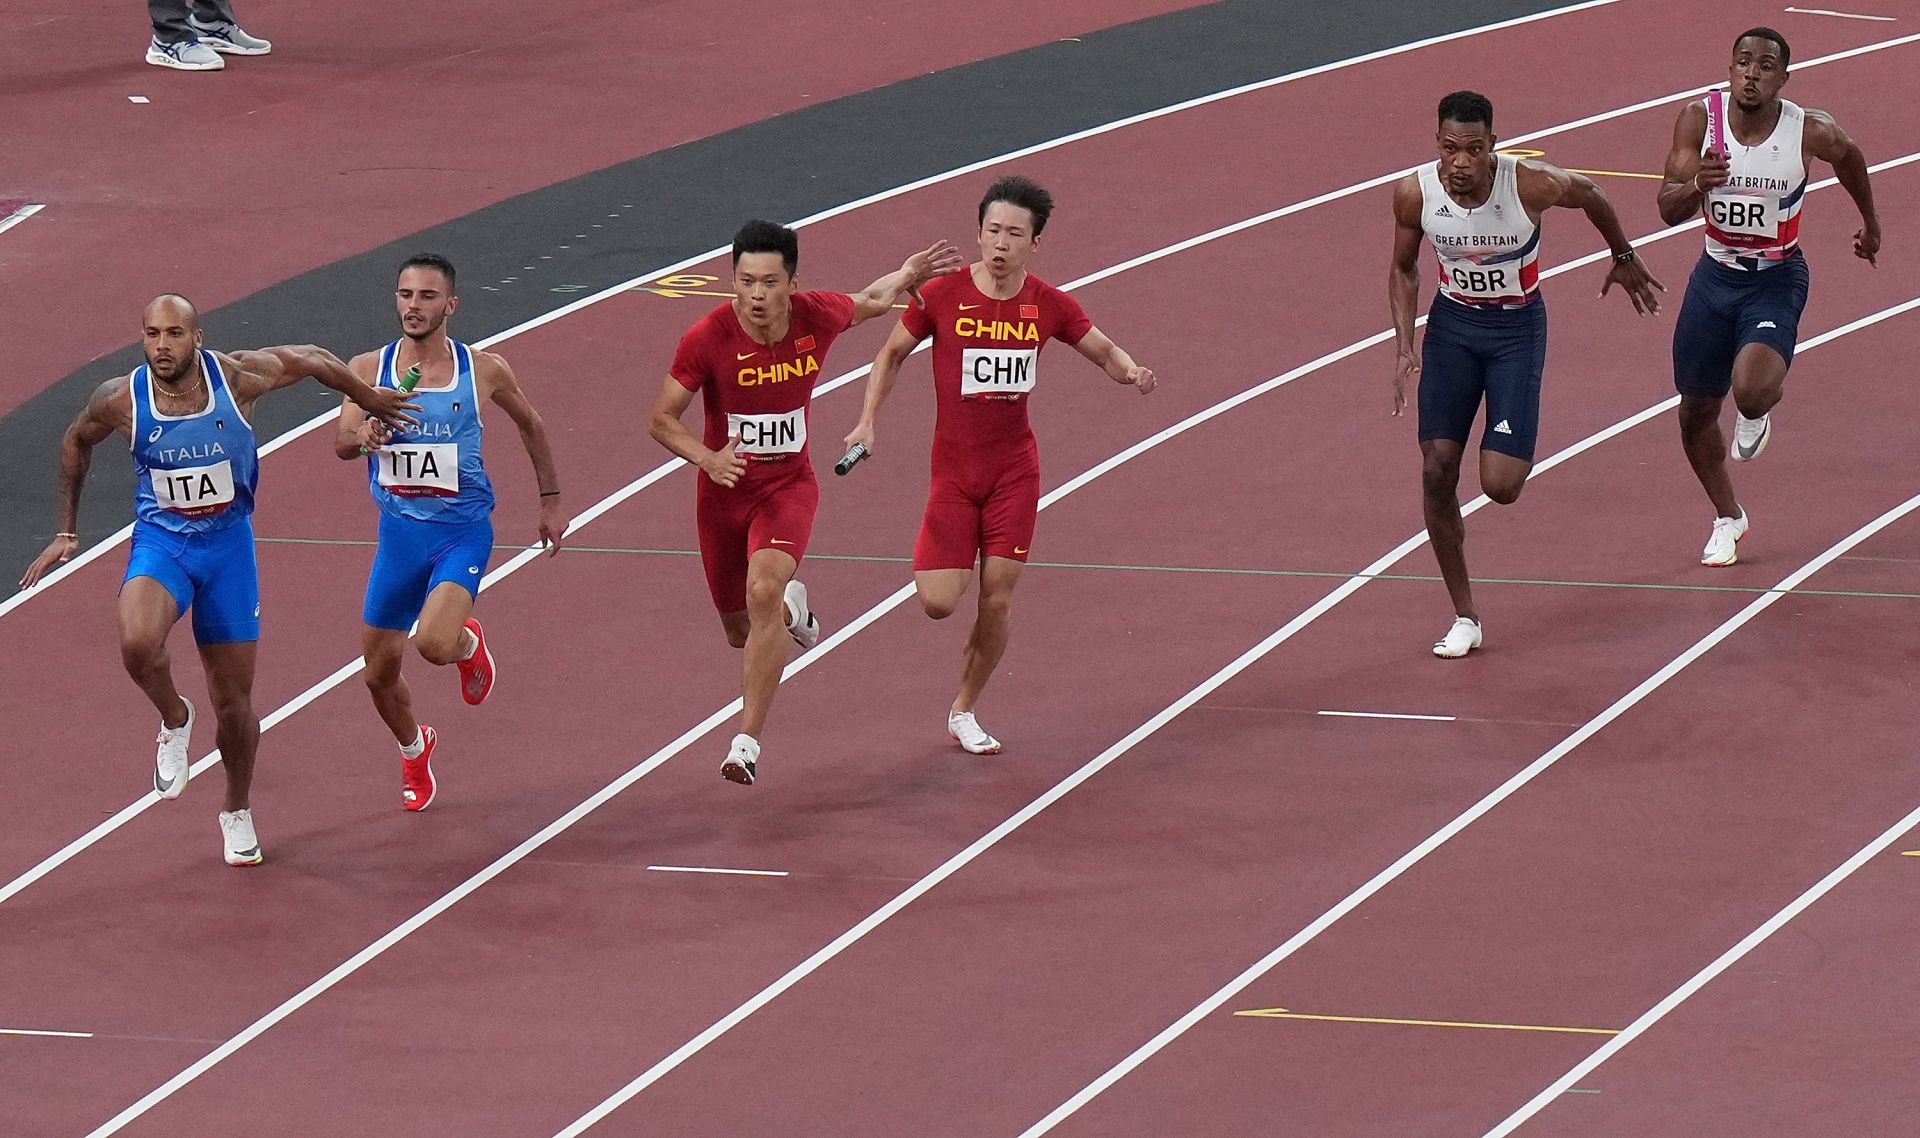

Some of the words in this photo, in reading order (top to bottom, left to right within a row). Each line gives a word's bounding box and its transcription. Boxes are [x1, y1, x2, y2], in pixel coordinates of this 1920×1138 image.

[1745, 176, 1788, 191] BRITAIN
[1711, 201, 1765, 228] GBR
[1435, 234, 1469, 246] GREAT
[1472, 235, 1519, 247] BRITAIN
[1452, 267, 1507, 292] GBR
[954, 317, 1040, 342] CHINA
[738, 354, 820, 387] CHINA
[974, 356, 1031, 385] CHN
[740, 416, 796, 447] CHN
[159, 441, 225, 464] ITALIA
[391, 450, 440, 479] ITA
[166, 473, 218, 502] ITA
